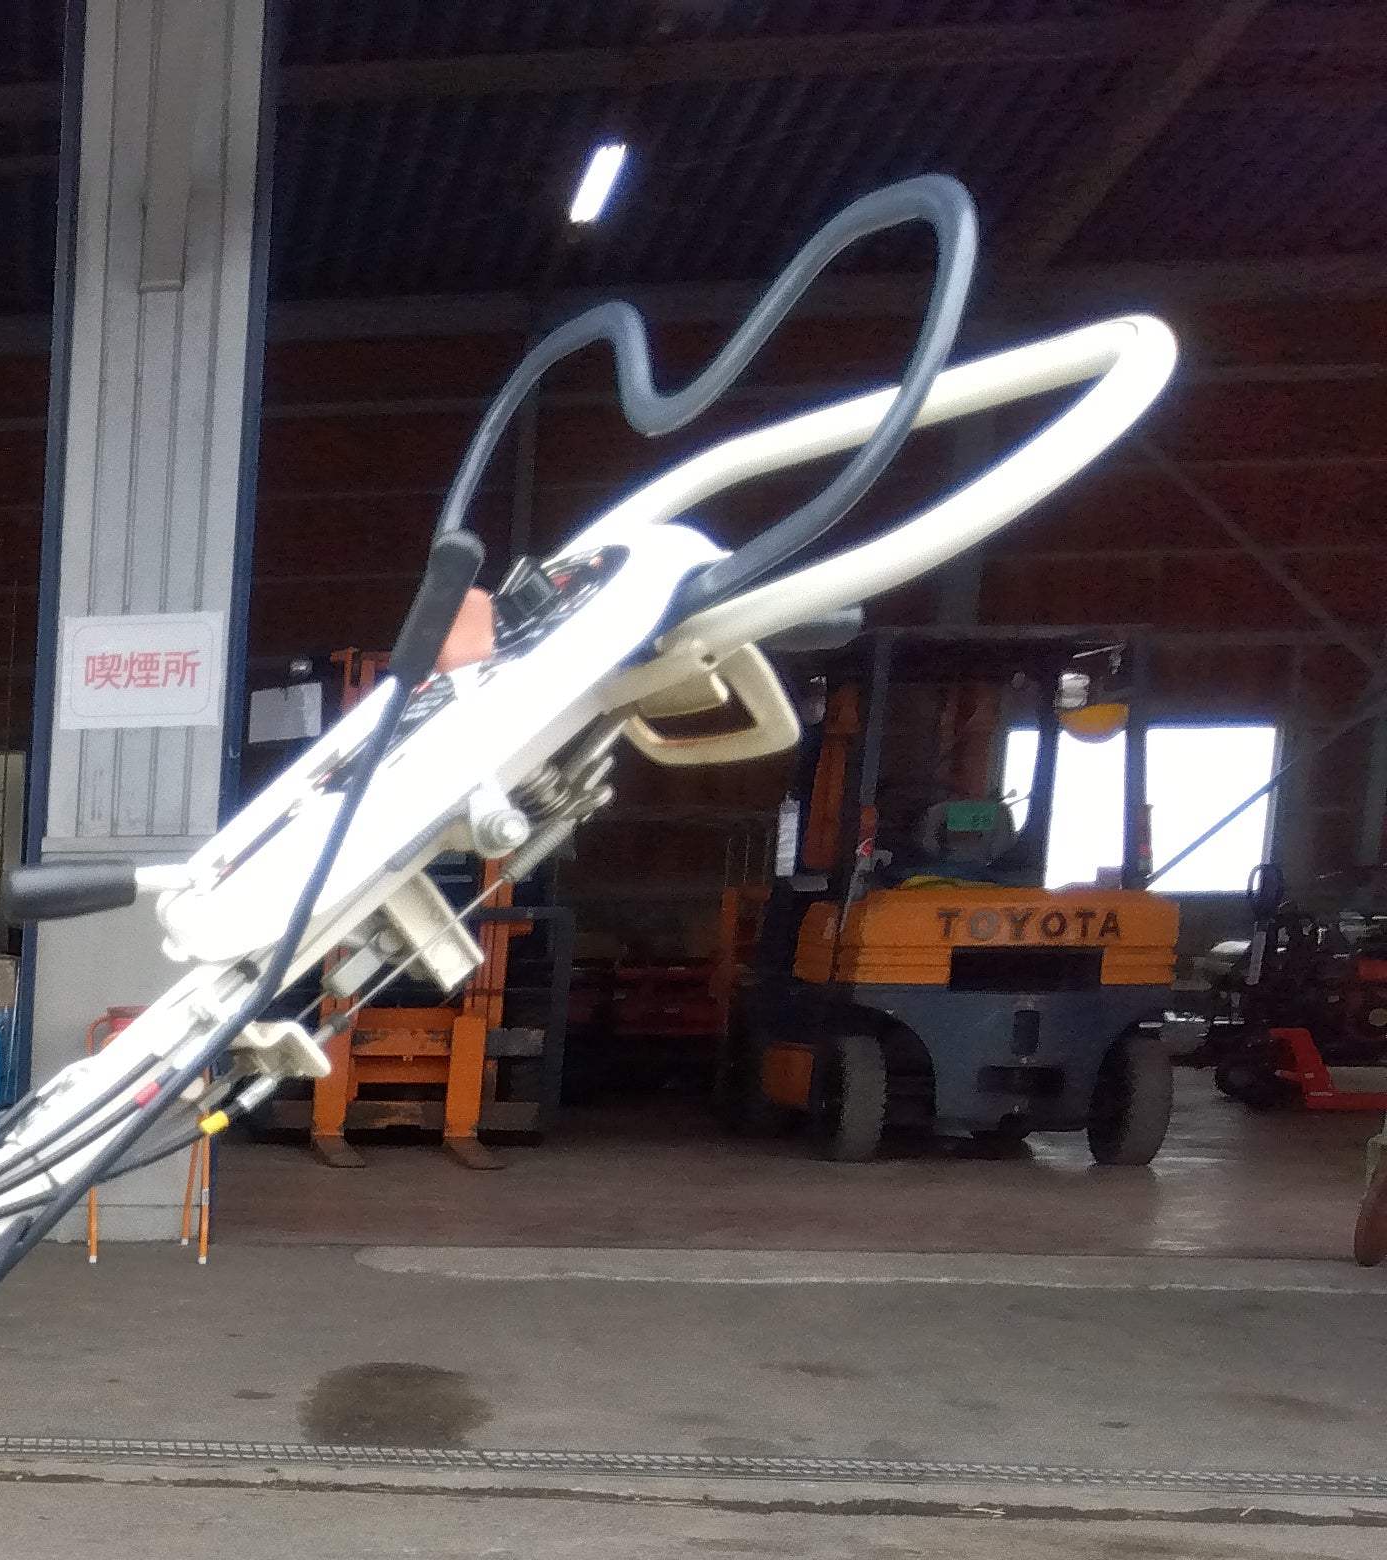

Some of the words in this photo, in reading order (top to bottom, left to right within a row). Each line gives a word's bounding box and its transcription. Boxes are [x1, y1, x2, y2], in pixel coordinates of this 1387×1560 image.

[85, 650, 201, 690] 喫煙所
[937, 907, 1121, 939] TOYOTA
